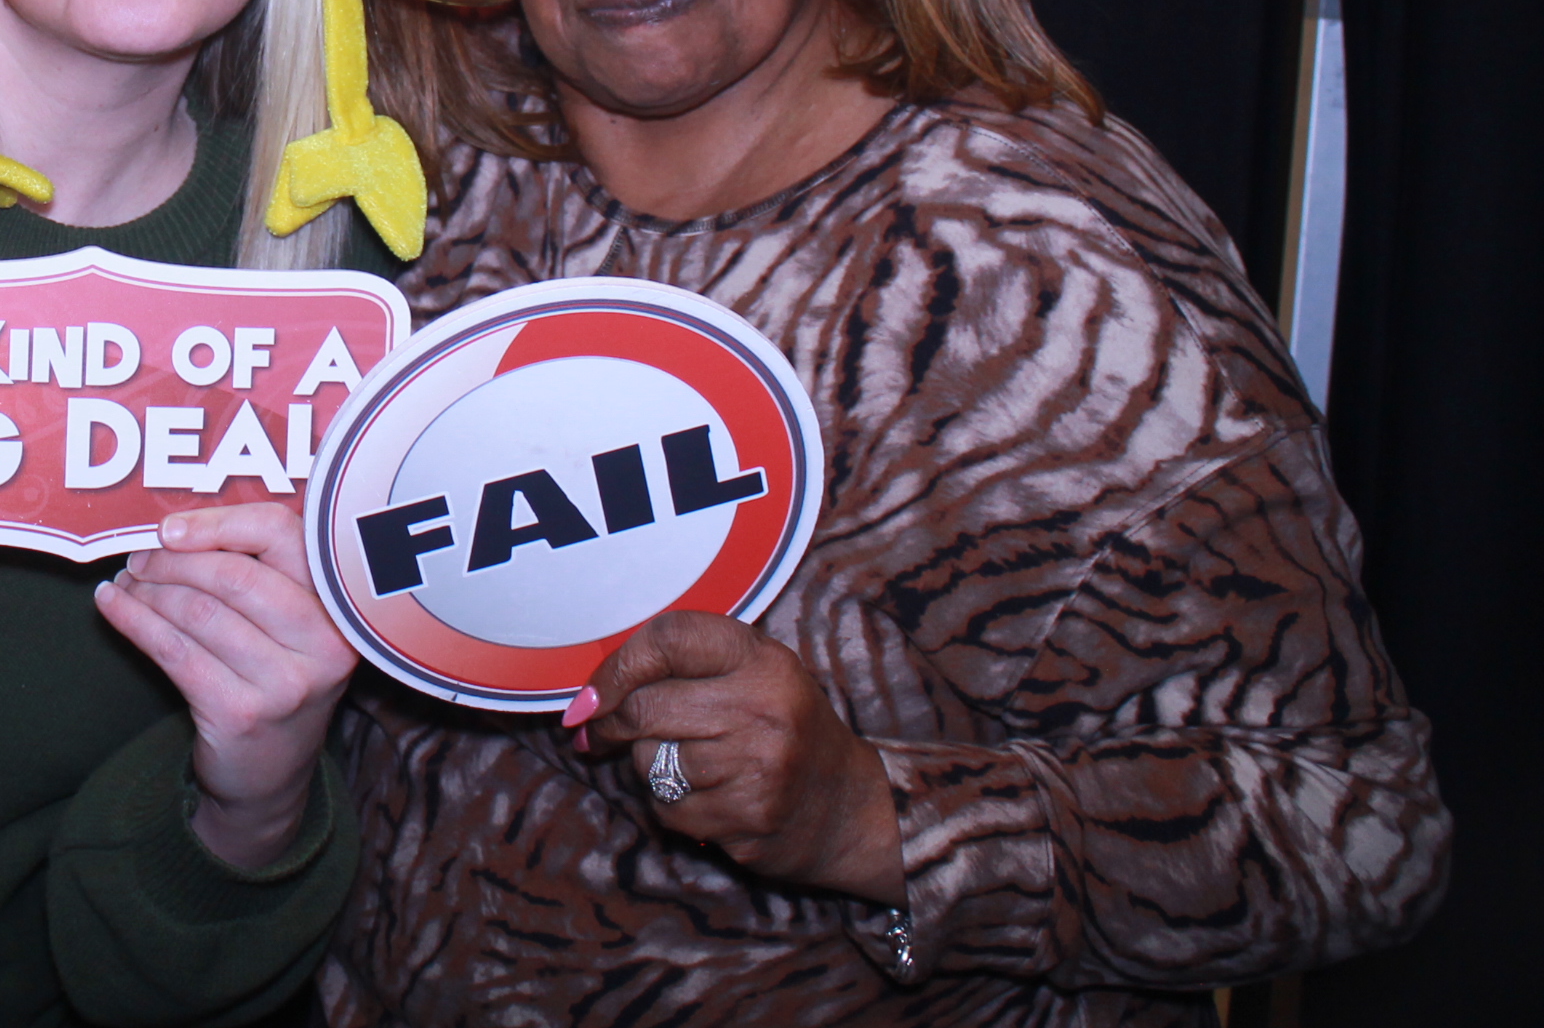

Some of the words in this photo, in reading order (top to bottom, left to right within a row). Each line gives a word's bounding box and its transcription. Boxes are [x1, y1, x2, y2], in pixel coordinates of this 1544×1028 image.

[172, 326, 275, 389] OF
[293, 326, 363, 396] A
[65, 397, 318, 494] DEAL
[354, 423, 766, 598] FAIL
